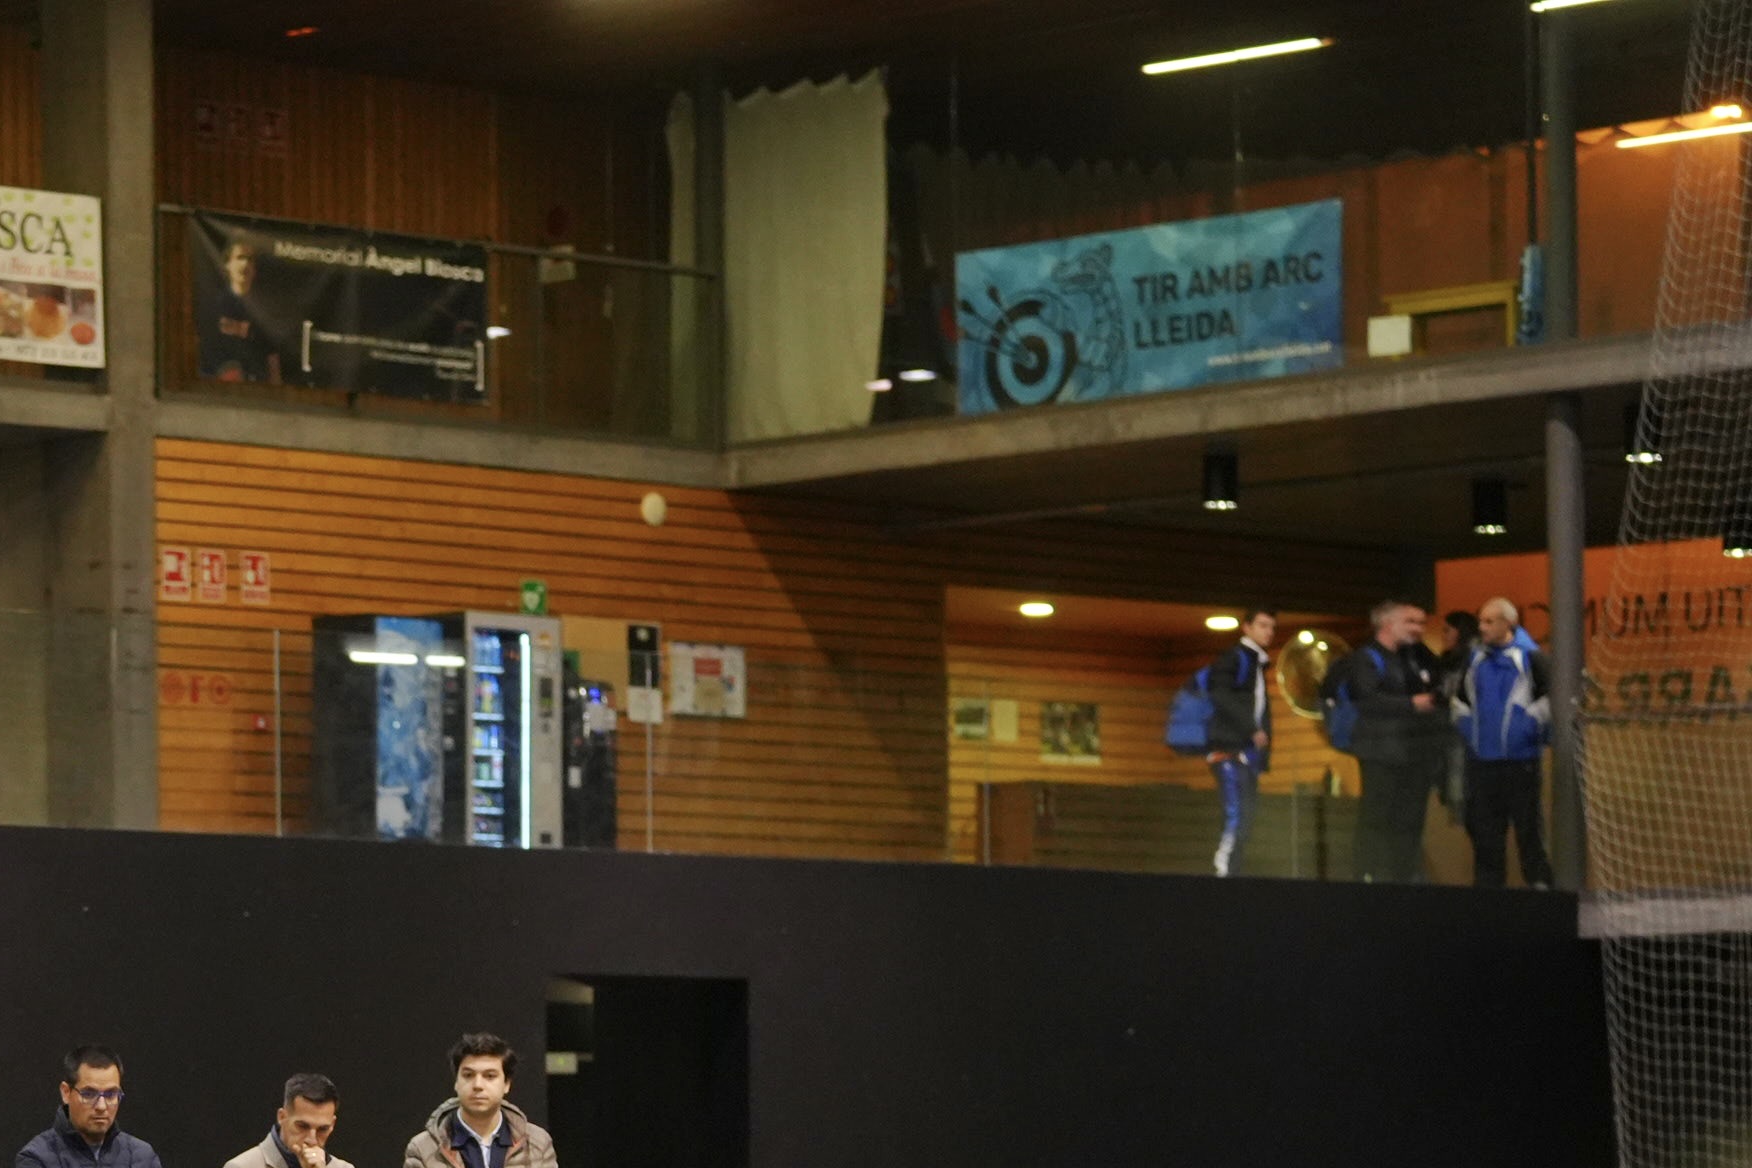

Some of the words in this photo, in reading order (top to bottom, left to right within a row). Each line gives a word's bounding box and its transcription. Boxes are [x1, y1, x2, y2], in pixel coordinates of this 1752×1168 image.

[1132, 272, 1179, 305] TIR
[1187, 260, 1254, 299] AMB
[1261, 251, 1324, 288] ARC
[1134, 308, 1237, 348] LLEIDA
